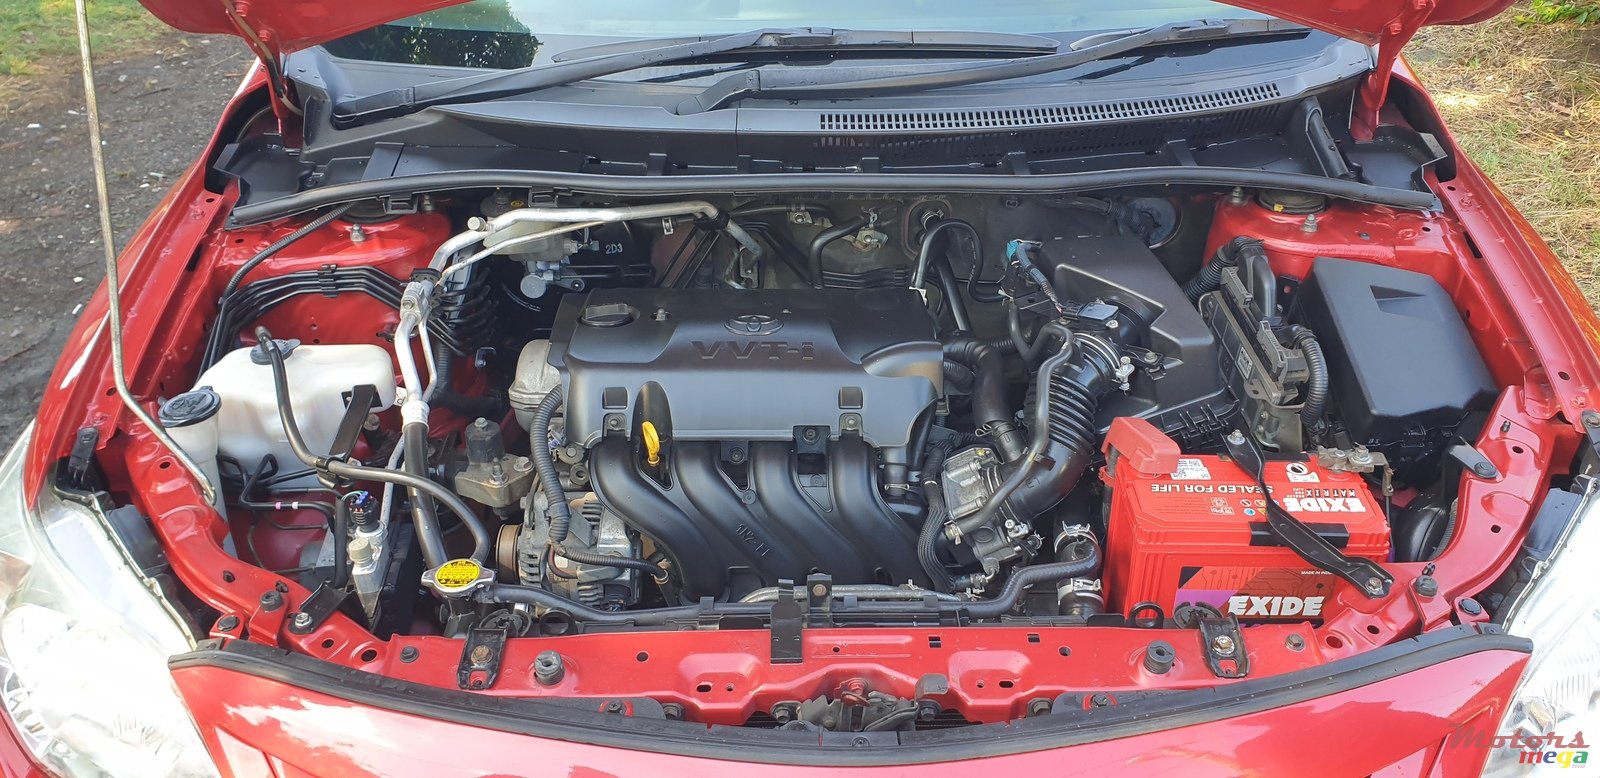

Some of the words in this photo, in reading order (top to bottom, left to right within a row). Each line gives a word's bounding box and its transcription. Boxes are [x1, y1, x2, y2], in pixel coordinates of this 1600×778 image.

[605, 243, 623, 254] 2D3
[1151, 484, 1180, 492] LIFE
[1184, 484, 1213, 493] FOR
[1306, 488, 1356, 497] MATRIX
[1282, 497, 1367, 513] EXIDE
[1228, 596, 1325, 616] EXIDE
